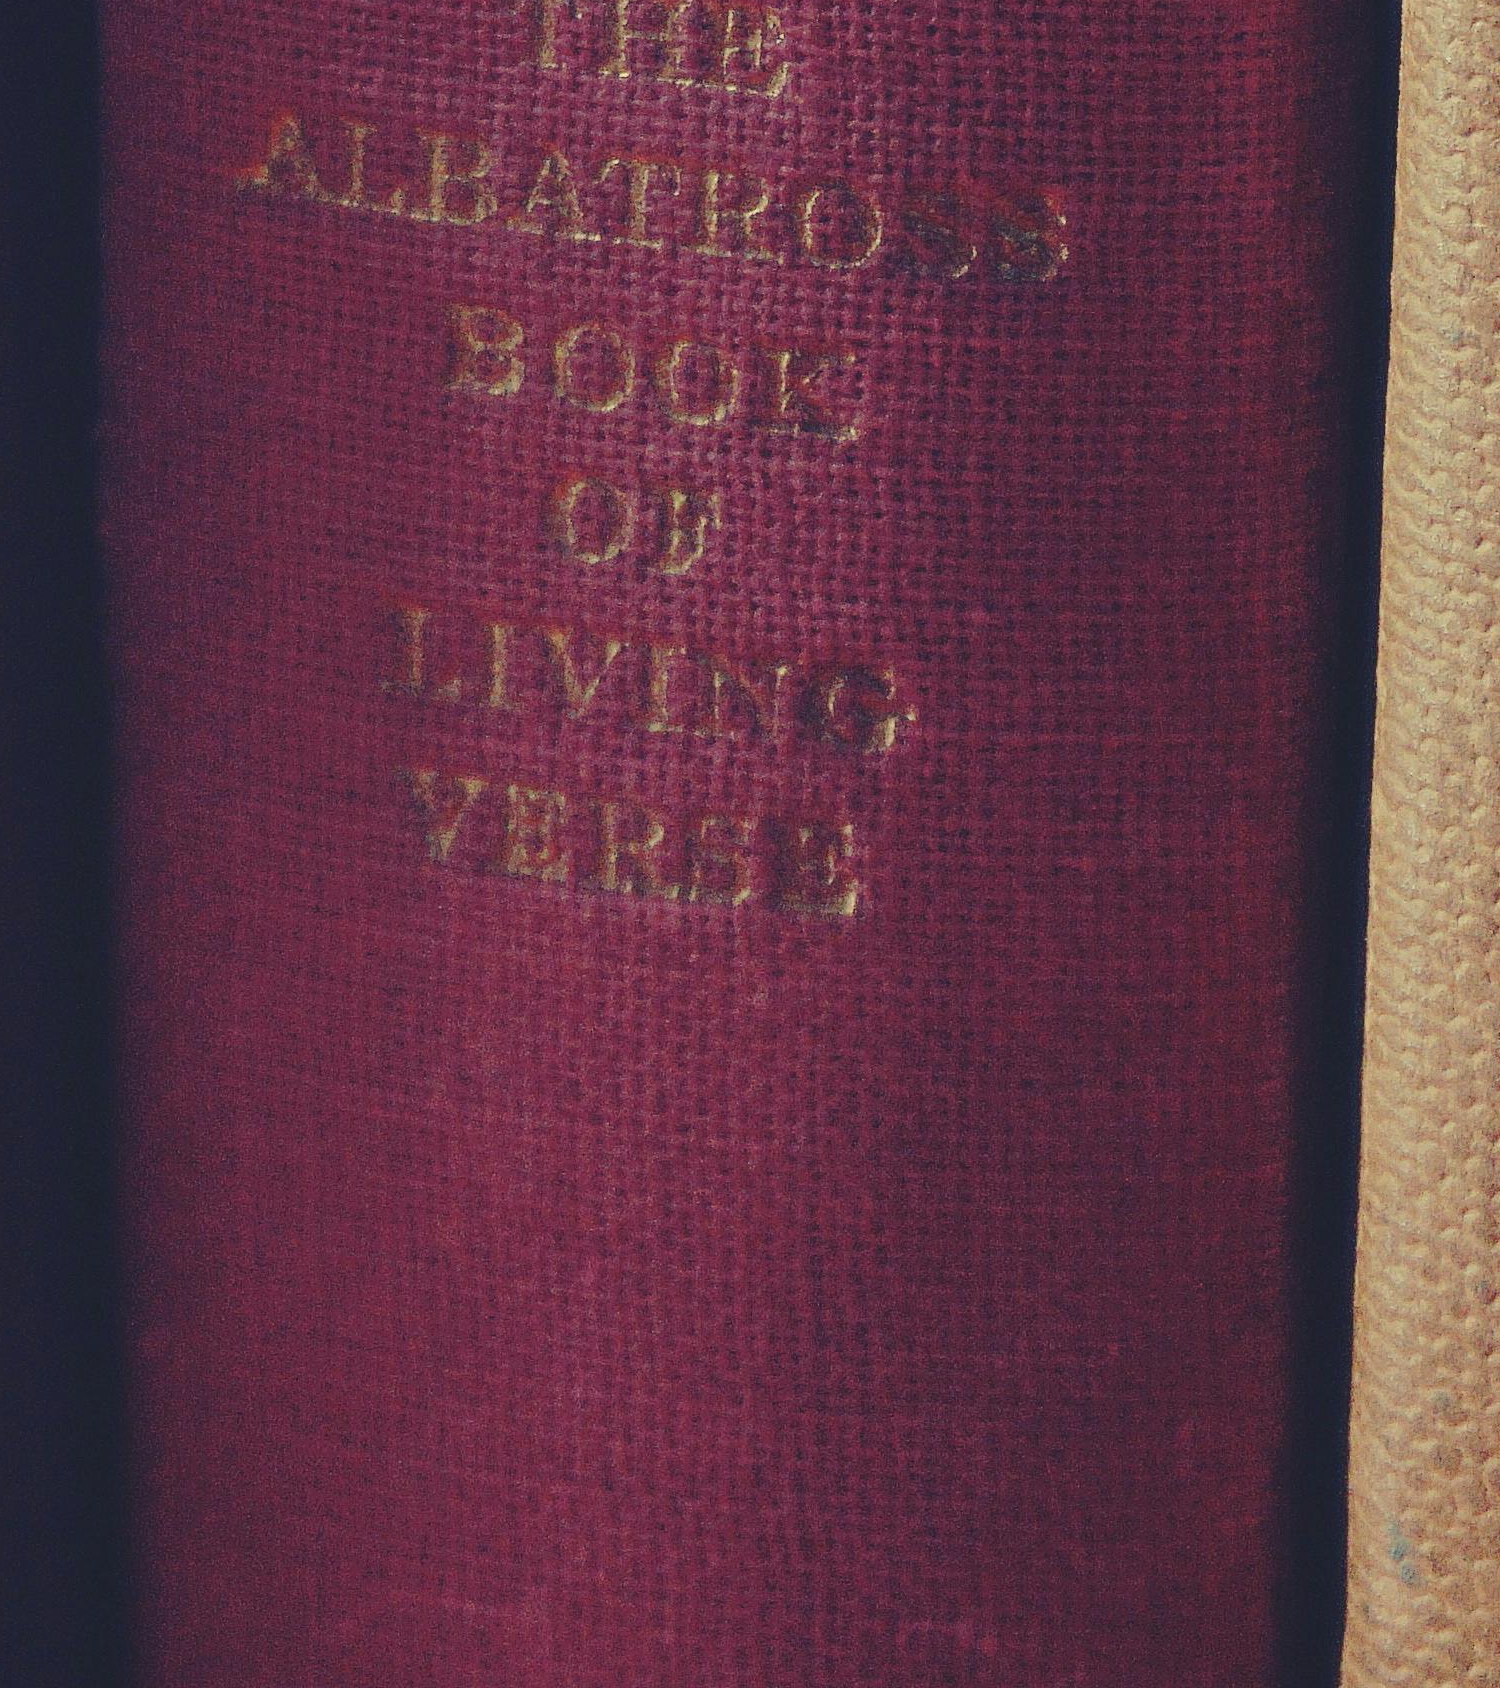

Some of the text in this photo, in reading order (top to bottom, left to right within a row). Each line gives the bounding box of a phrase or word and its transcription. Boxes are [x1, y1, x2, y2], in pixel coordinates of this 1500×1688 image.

[238, 112, 1068, 282] ALBATROSS
[448, 307, 860, 440] BOOK
[552, 476, 720, 575] OF
[382, 604, 918, 752] LIVING
[402, 767, 860, 917] VERSE
